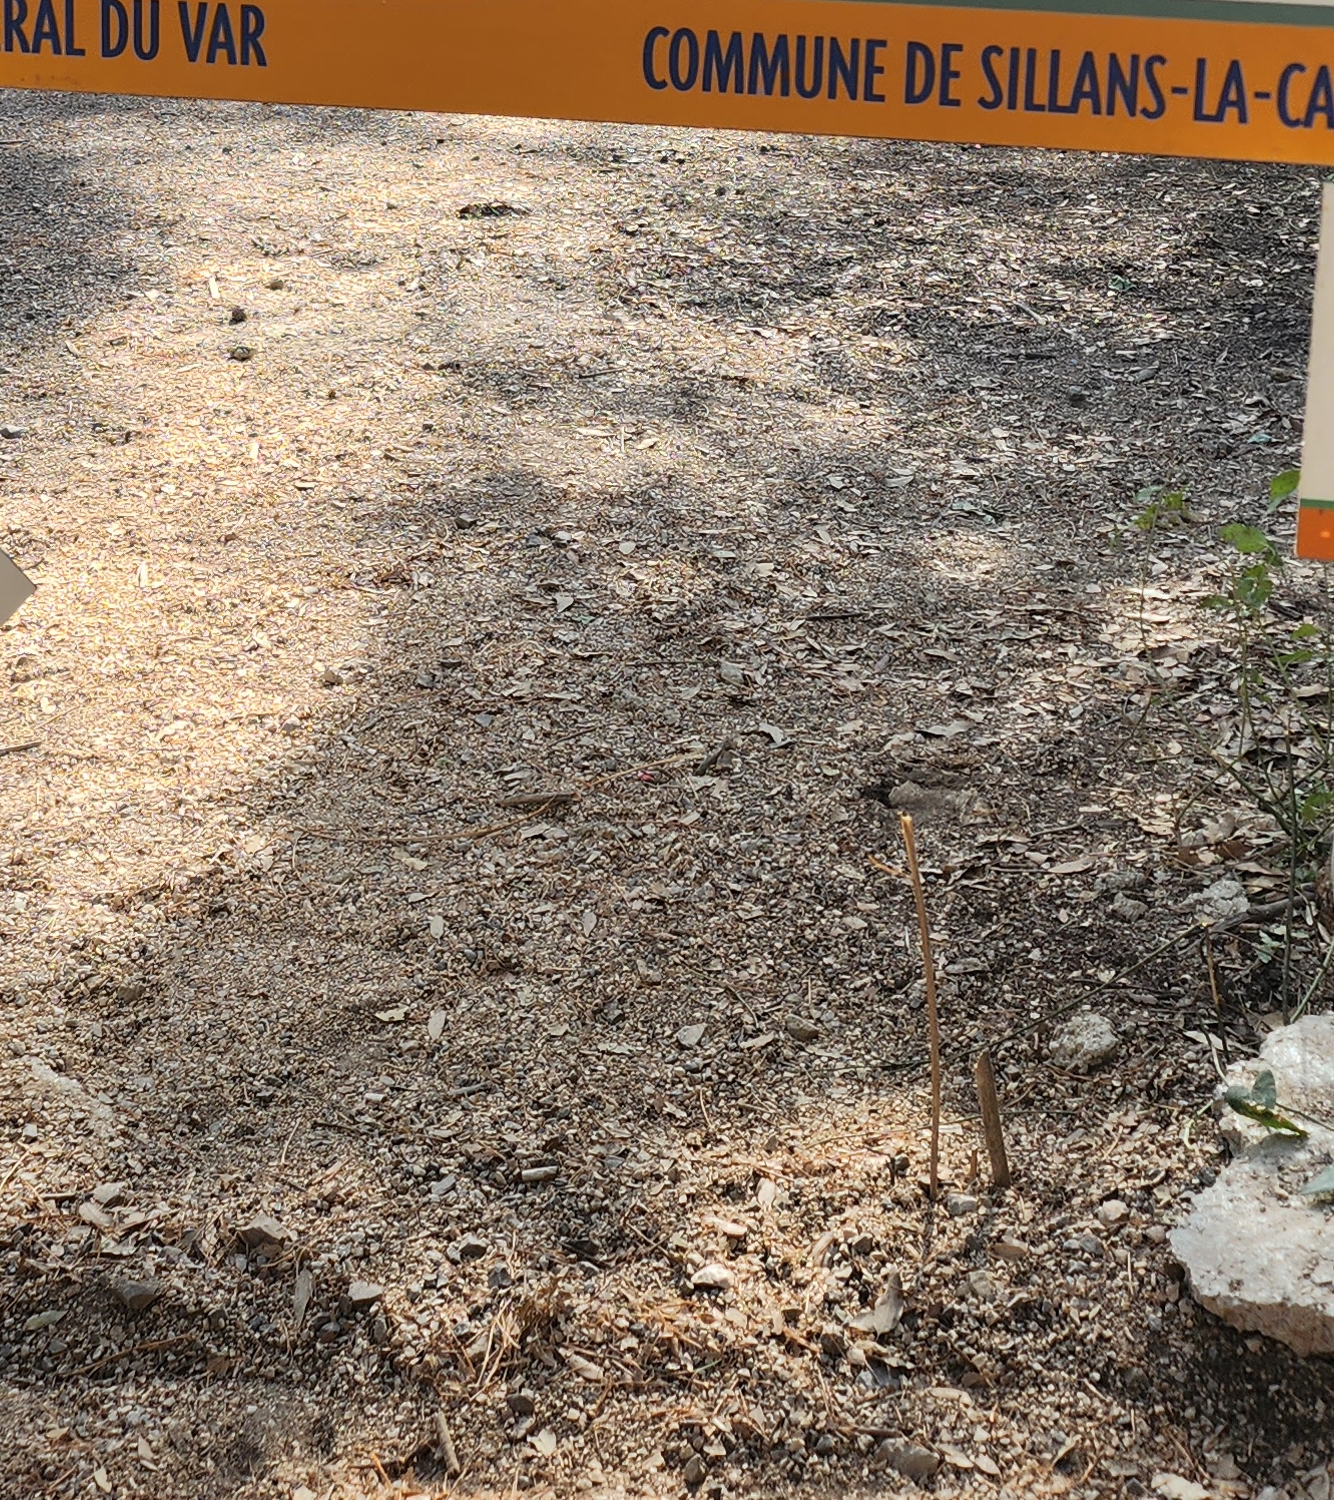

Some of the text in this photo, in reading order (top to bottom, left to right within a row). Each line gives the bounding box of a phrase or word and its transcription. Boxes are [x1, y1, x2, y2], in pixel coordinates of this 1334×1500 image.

[178, 1, 268, 67] VAR
[642, 26, 888, 103] COMMUNE
[904, 41, 963, 108] DE
